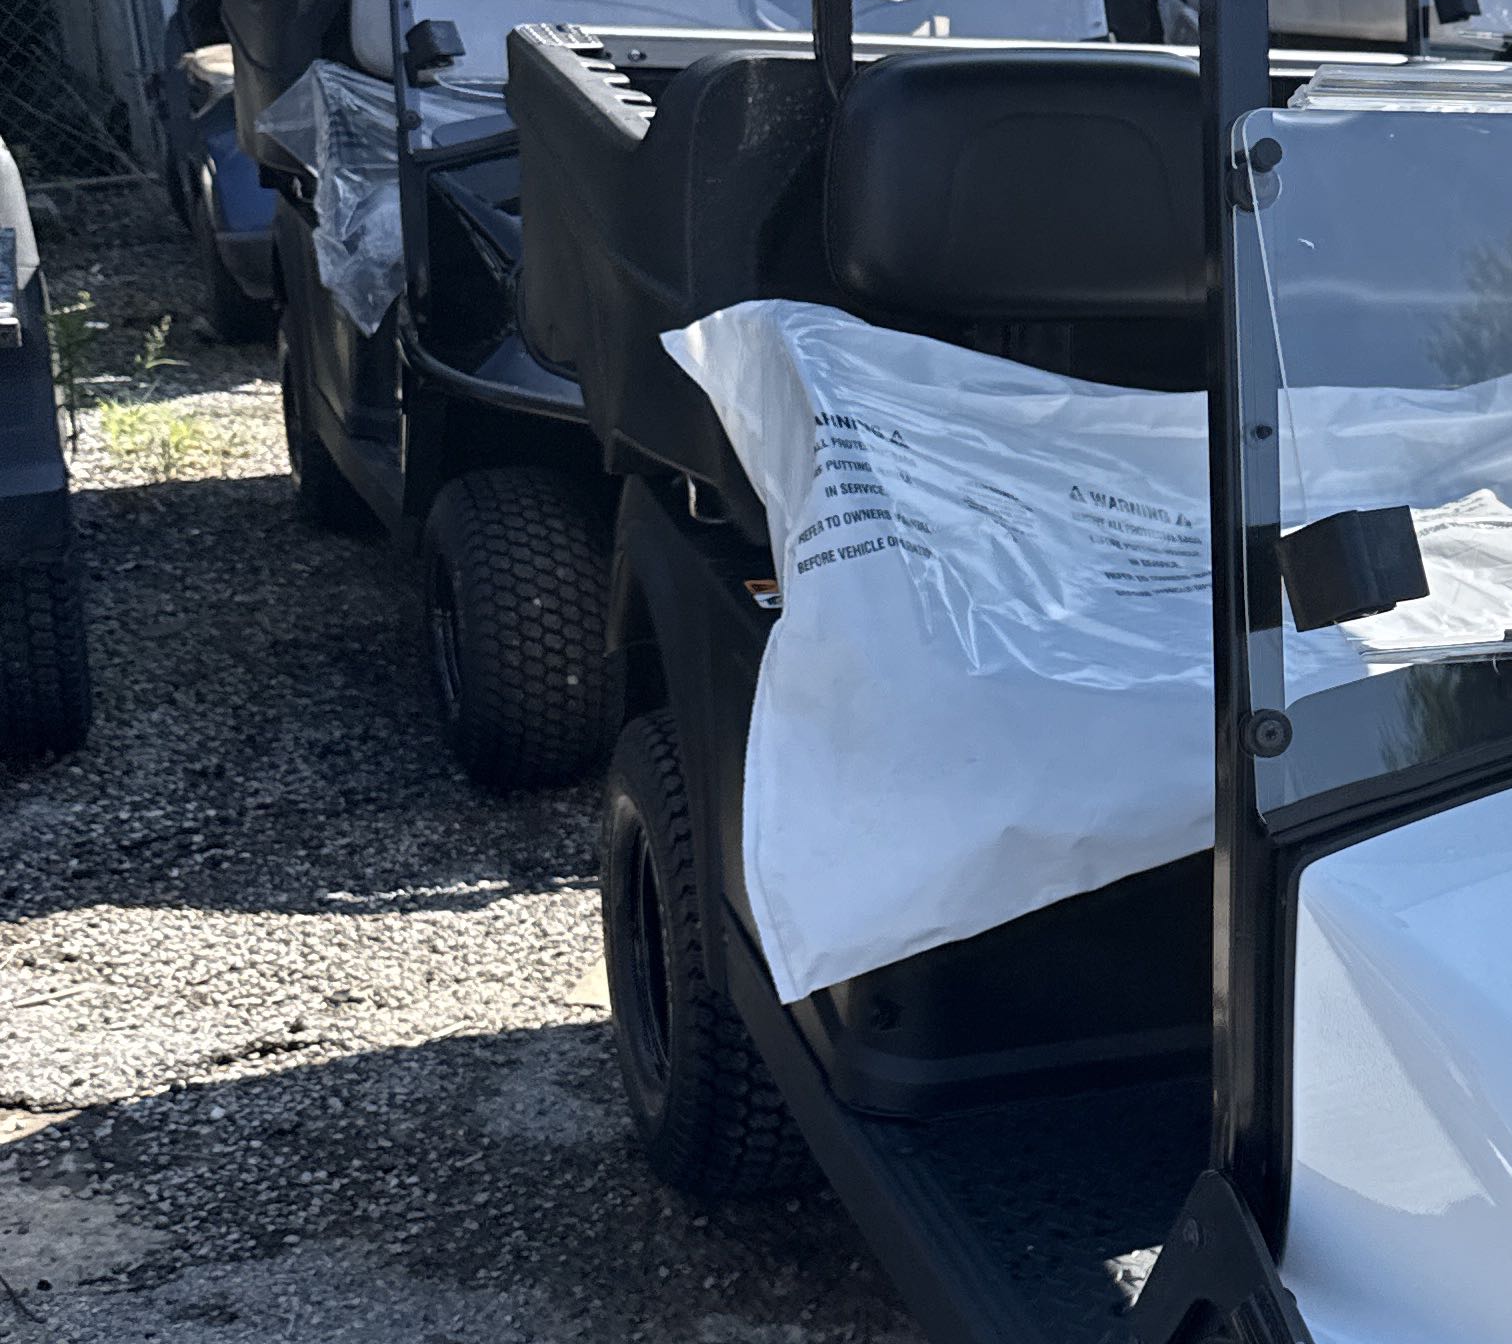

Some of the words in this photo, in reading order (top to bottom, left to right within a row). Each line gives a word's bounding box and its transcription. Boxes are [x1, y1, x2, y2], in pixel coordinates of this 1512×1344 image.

[825, 459, 872, 472] PUTTING
[824, 484, 838, 498] IN
[825, 514, 841, 529] TO
[797, 549, 837, 575] BEFORE
[838, 537, 885, 561] VEHICLE
